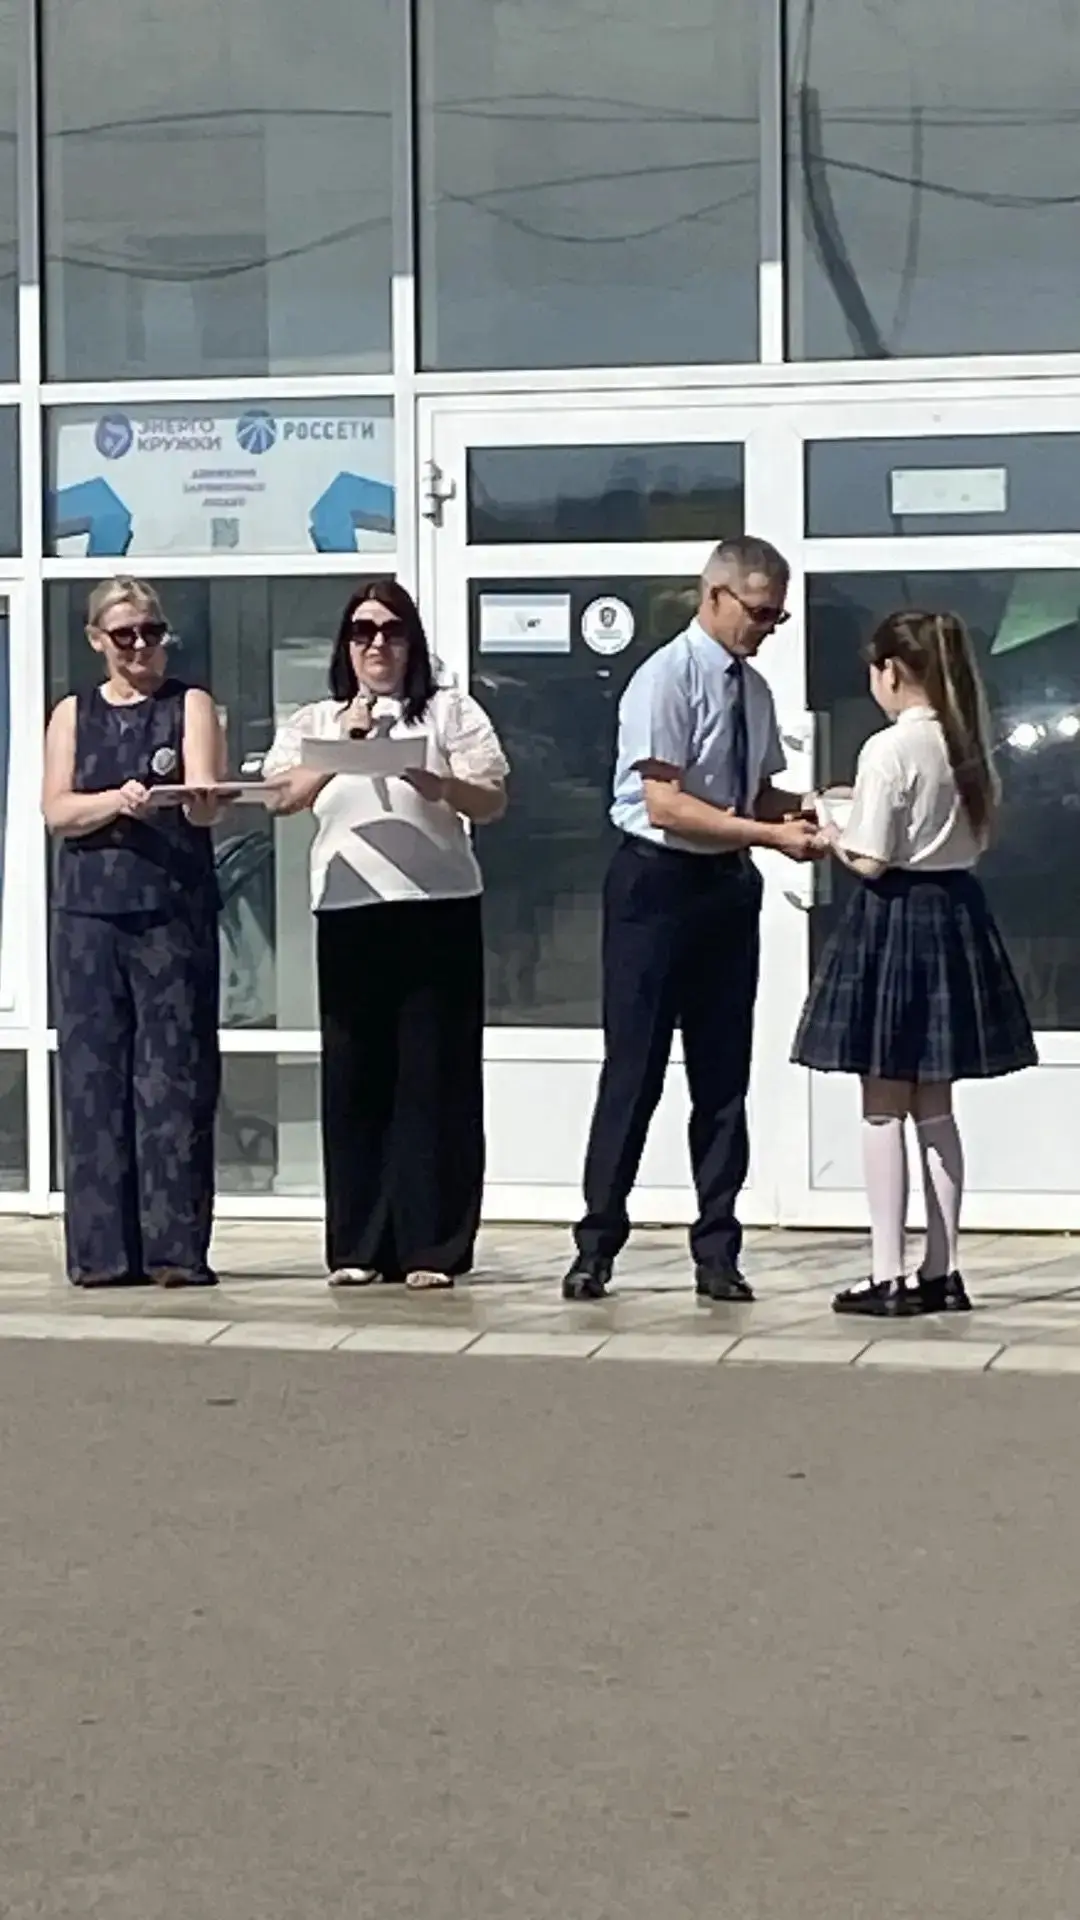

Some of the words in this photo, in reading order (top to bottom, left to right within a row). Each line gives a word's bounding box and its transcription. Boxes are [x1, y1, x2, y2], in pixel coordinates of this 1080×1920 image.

[137, 417, 215, 434] ЭНЕРГО
[283, 421, 375, 440] РОССЕТИ
[137, 436, 222, 452] КРУЖКИ
